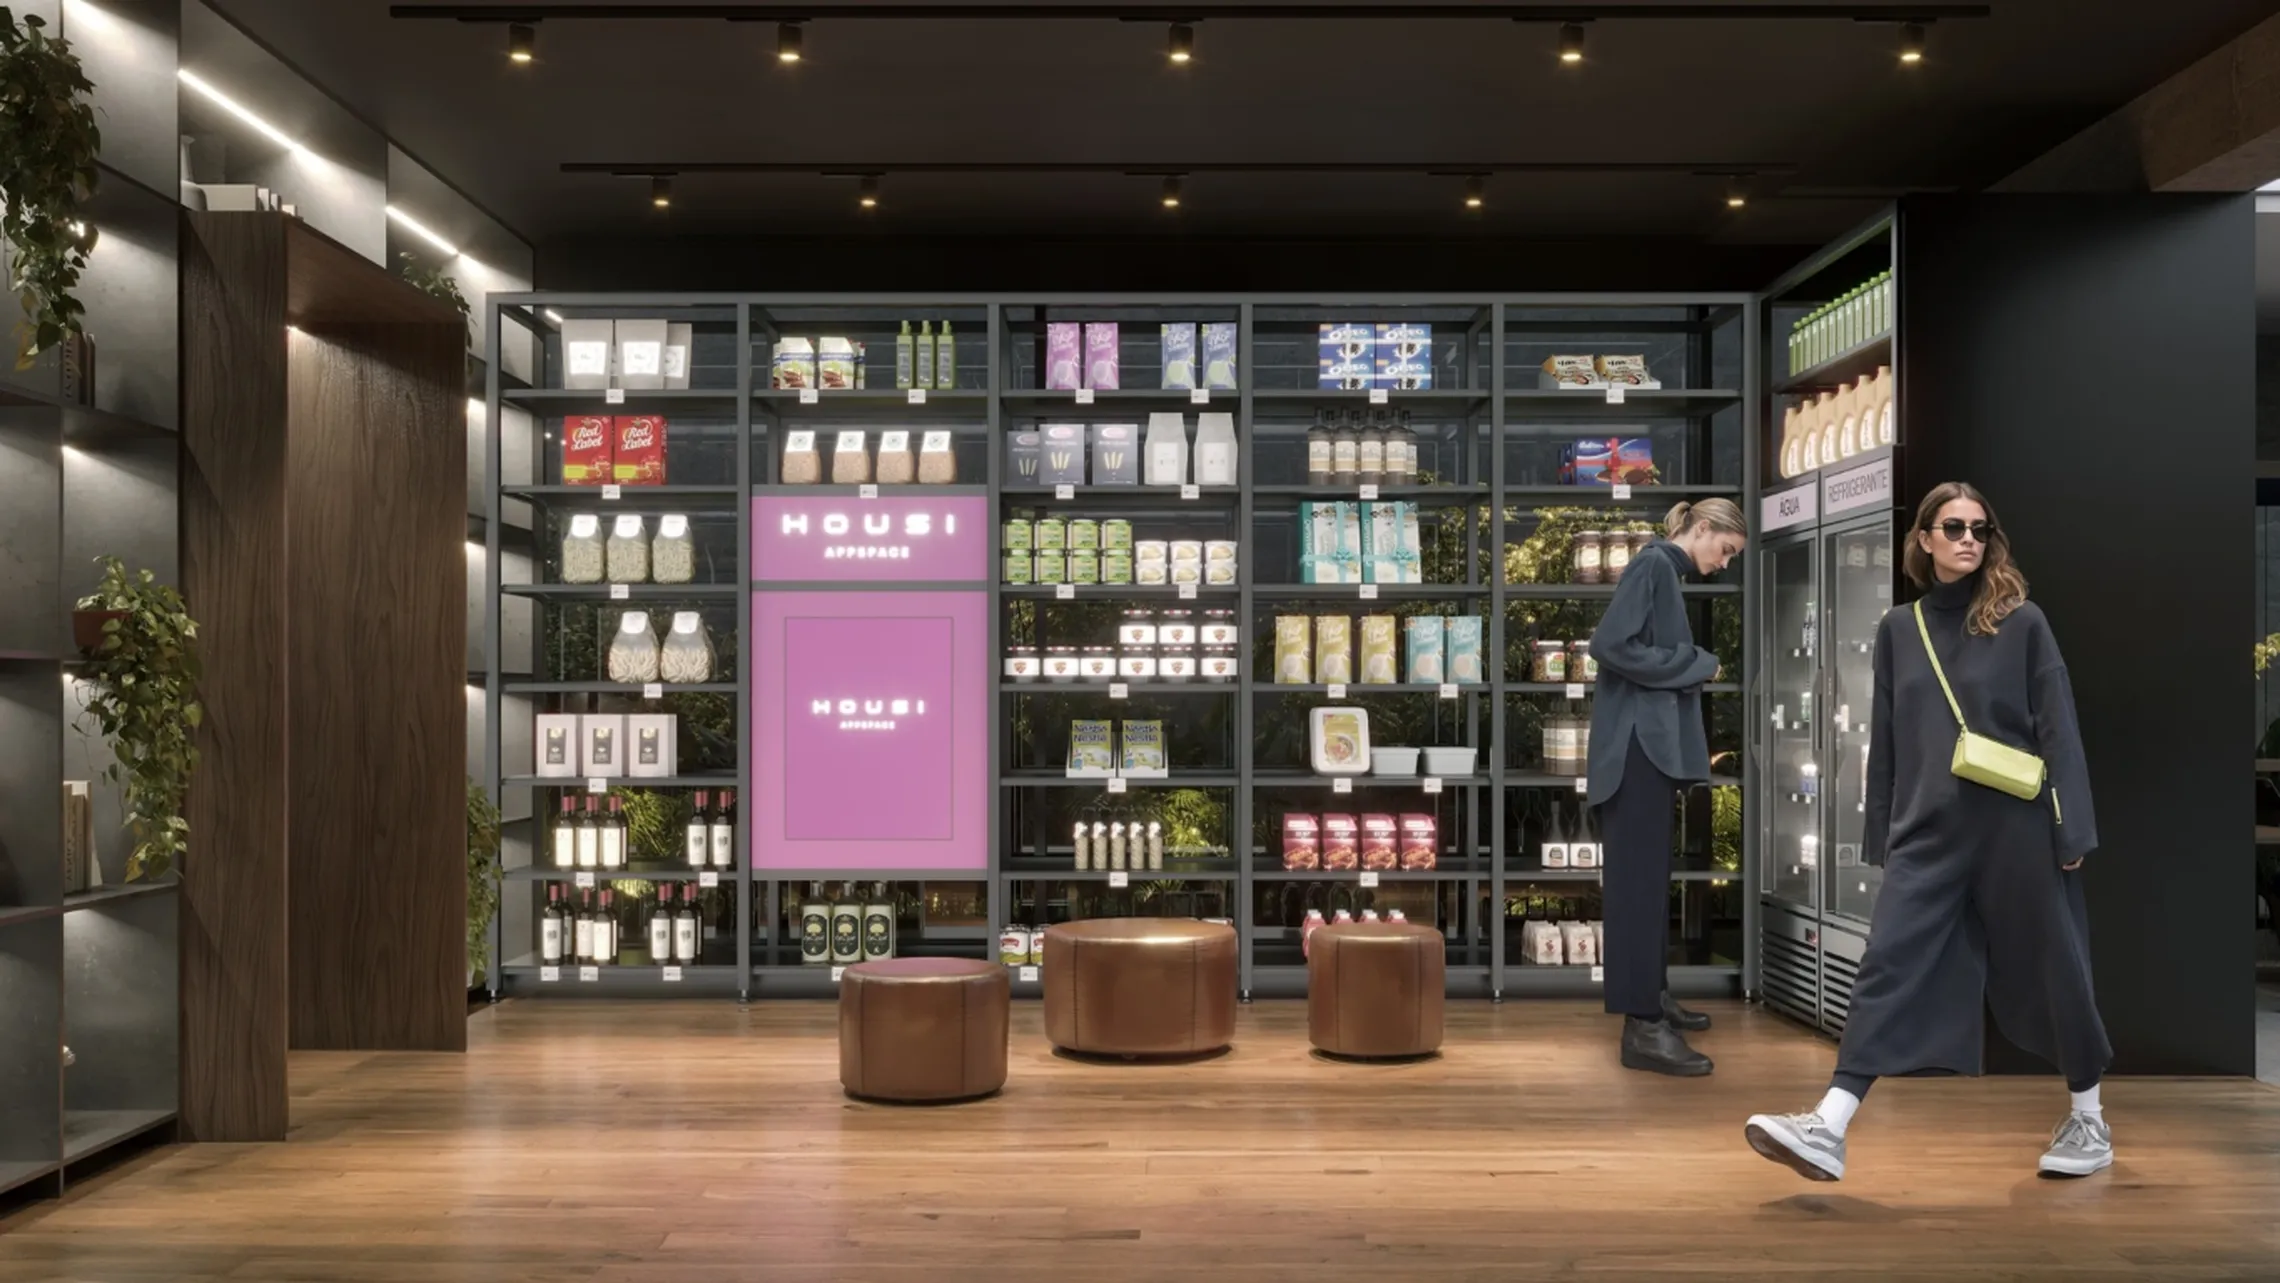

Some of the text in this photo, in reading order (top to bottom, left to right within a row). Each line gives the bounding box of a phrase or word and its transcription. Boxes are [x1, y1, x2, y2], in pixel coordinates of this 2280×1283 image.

[577, 424, 600, 438] Red
[627, 424, 650, 438] Red
[571, 434, 603, 451] Label
[621, 434, 653, 451] Label
[1828, 468, 1888, 503] REFRIGERANTE
[781, 513, 956, 535] HOUSI
[823, 545, 911, 559] APPSPACE
